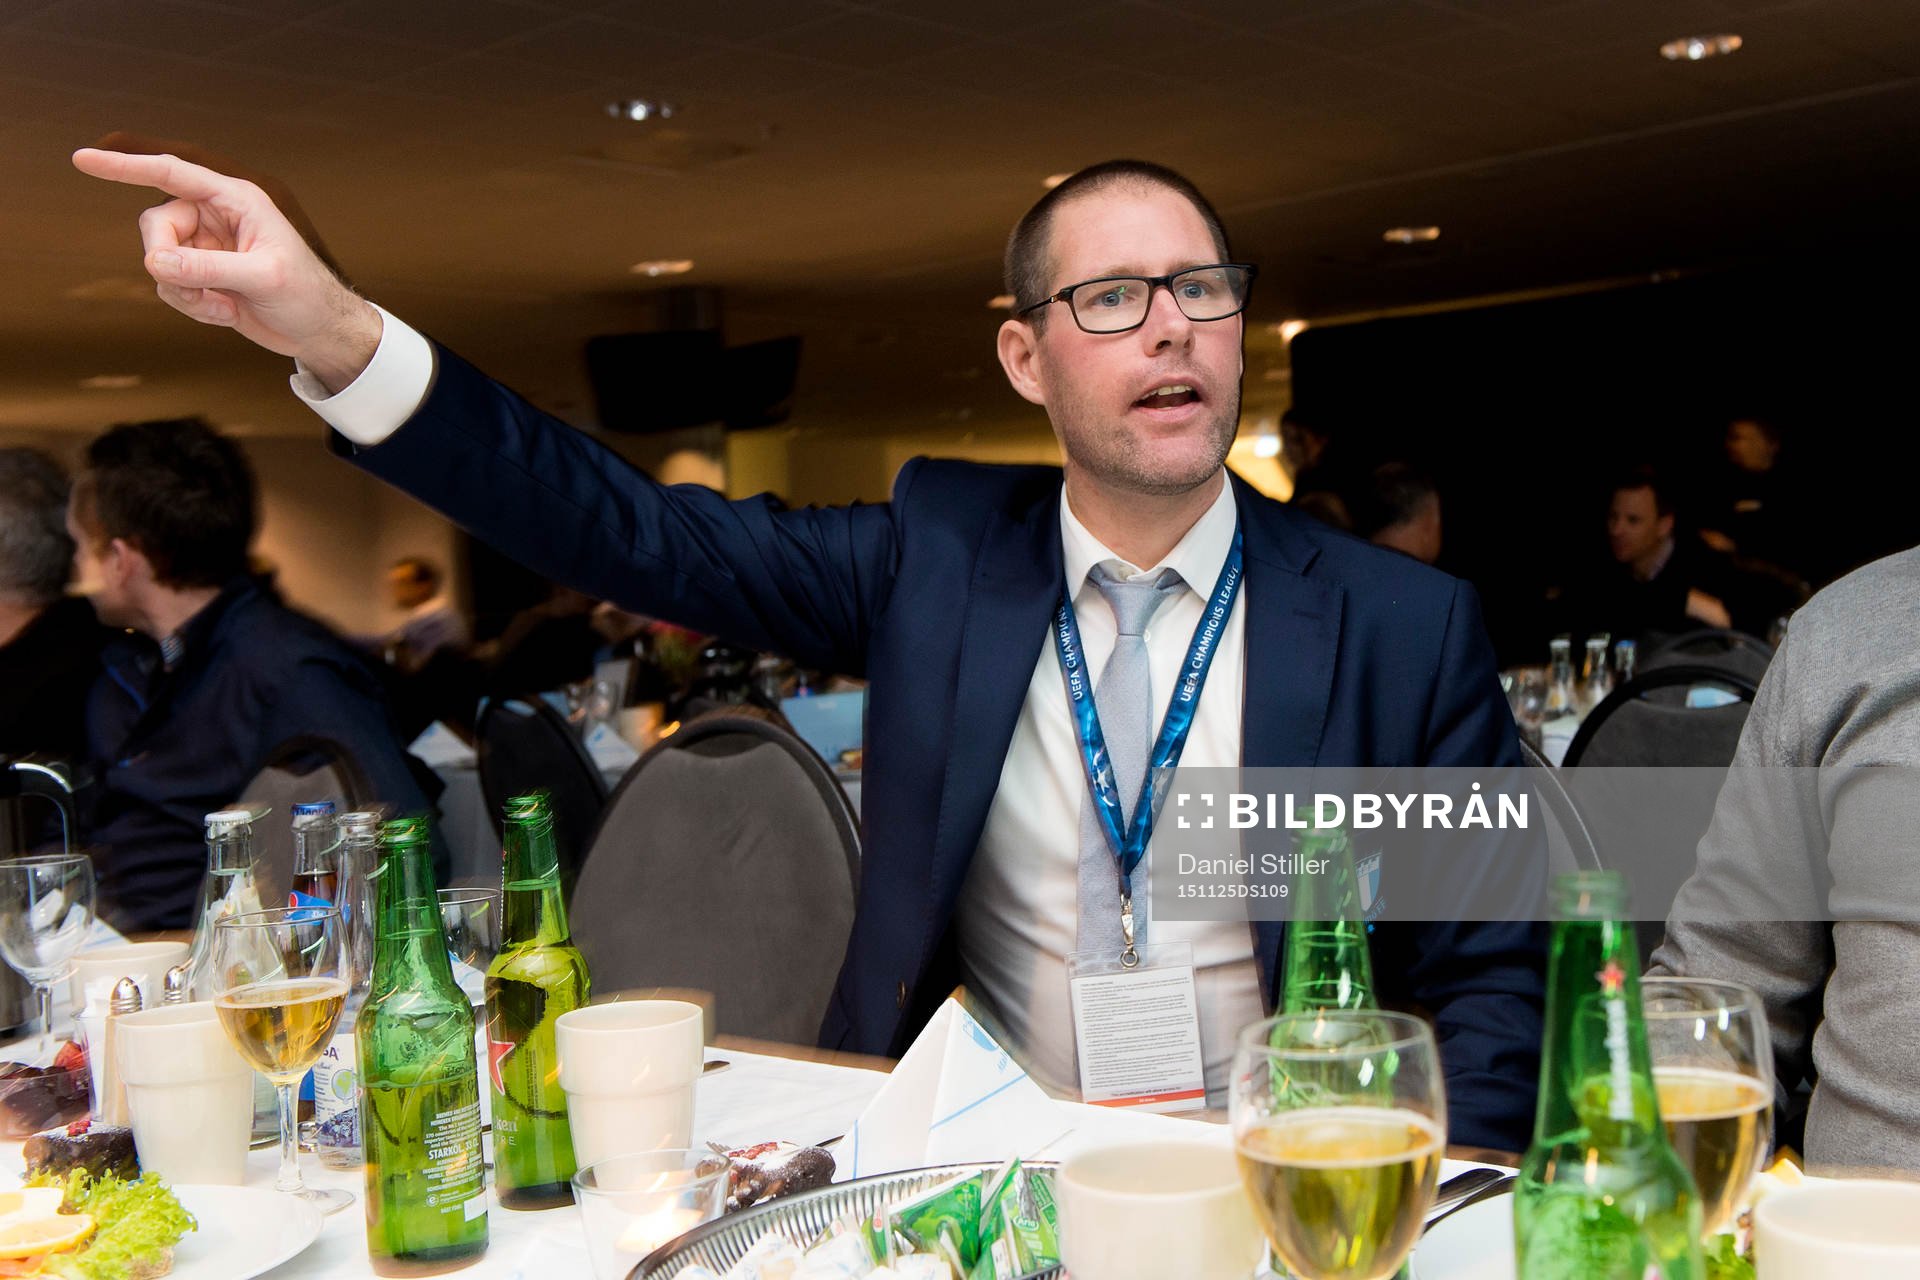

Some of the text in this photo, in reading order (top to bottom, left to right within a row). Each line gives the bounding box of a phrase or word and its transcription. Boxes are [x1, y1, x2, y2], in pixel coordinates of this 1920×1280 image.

[1070, 669, 1083, 701] UEFA
[1180, 671, 1199, 702] UEFA
[1192, 606, 1224, 669] CHAMPIONS
